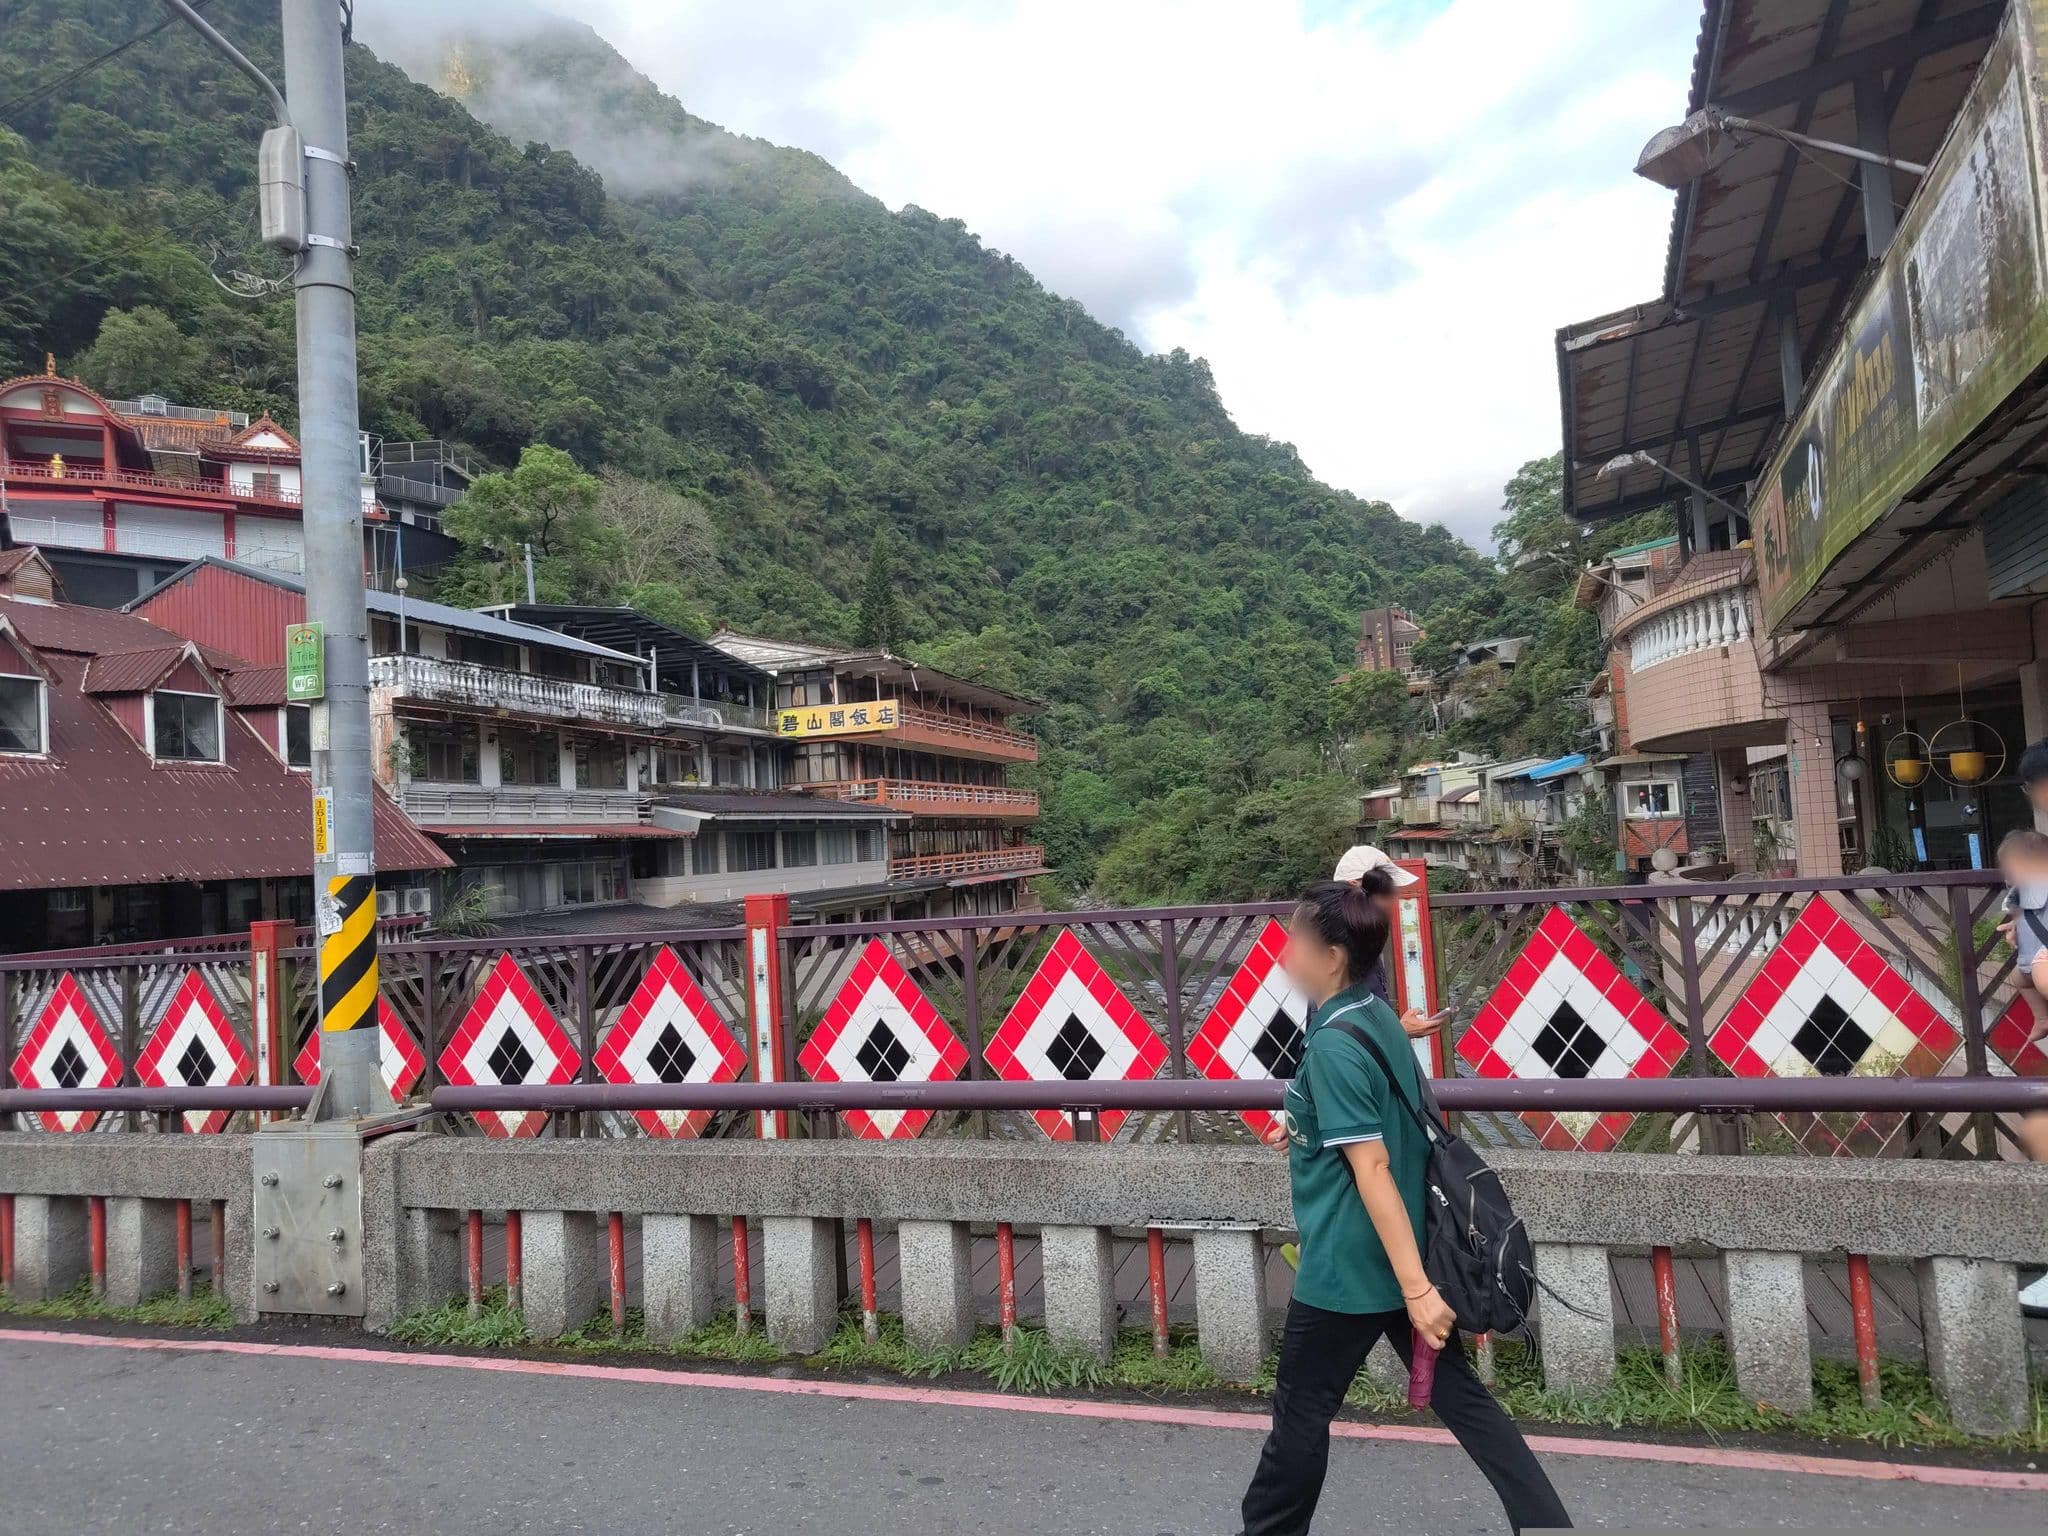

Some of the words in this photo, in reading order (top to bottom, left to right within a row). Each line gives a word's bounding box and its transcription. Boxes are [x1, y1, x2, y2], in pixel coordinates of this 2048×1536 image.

[782, 706, 894, 732] 碧山閣飯店
[316, 800, 325, 851] 161475
